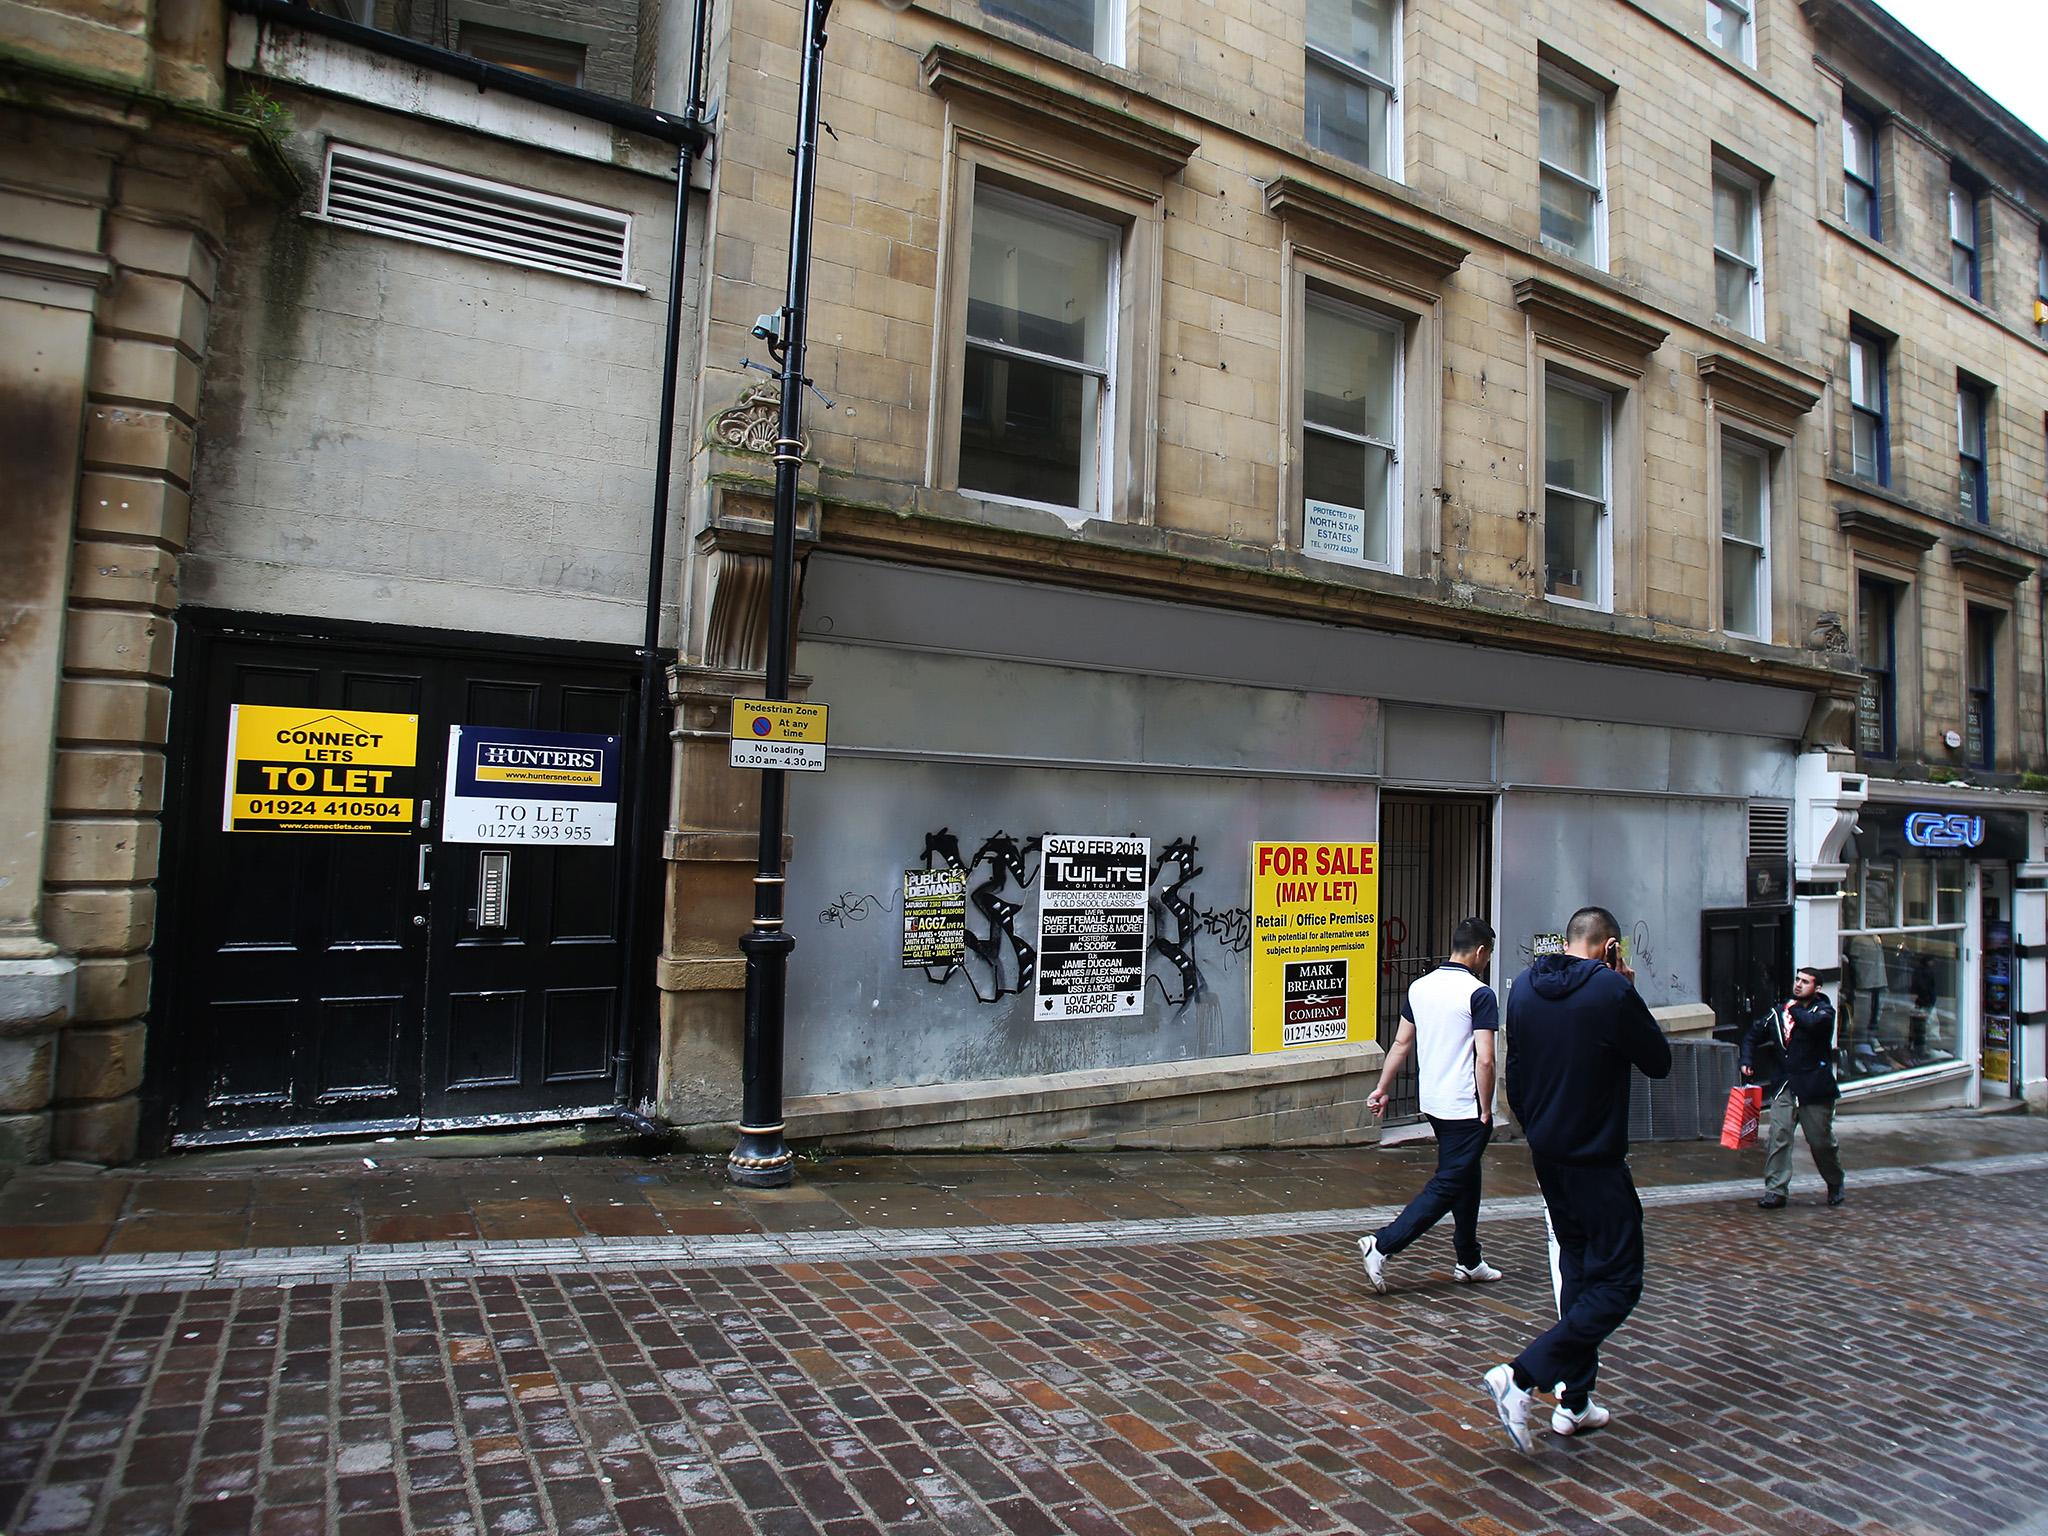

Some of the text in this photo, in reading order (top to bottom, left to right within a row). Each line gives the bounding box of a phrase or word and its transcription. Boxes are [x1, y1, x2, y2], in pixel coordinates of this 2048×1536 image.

[1313, 506, 1347, 518] PROTECTED
[1310, 516, 1359, 533] NORTH STAR
[1318, 529, 1352, 543] ESTATES
[744, 703, 818, 715] Pedestrian Zone
[276, 730, 383, 747] CONNECT
[784, 729, 803, 737] time
[305, 749, 353, 762] LETS
[771, 745, 804, 755] loading
[485, 747, 595, 768] HUNTERS
[735, 755, 761, 764] 10.30
[784, 758, 806, 766] 4.30
[262, 766, 392, 793] TO LET
[505, 772, 593, 782] www.huntersnet.co.uk
[250, 800, 401, 816] 01924 410504
[495, 805, 580, 822] TO LET
[477, 824, 592, 840] 01274 393 955
[1050, 840, 1144, 855] SAT 9 FEB 2013
[1260, 847, 1373, 876] FOR SALE
[909, 872, 949, 886] PUBLIC
[908, 882, 962, 897] DEMAND
[1276, 882, 1357, 907] (MAY LET)
[918, 917, 946, 930] AGGZ
[1043, 915, 1144, 924] SWEET FEMALE ATTITUDE
[1256, 915, 1287, 927] Retail
[1296, 913, 1326, 926] Office
[1330, 912, 1374, 925] Premises
[1069, 924, 1108, 933] FLOWERS
[1109, 924, 1115, 932] &
[1116, 923, 1141, 932] MORE!
[1261, 933, 1276, 942] with
[1278, 932, 1308, 943] potential
[1320, 930, 1354, 939] alternative
[1536, 936, 1557, 946] PUBLIC
[1070, 942, 1116, 951] MC SCORPZ
[1266, 945, 1291, 956] subject
[1301, 944, 1329, 957] planning
[1331, 942, 1364, 954] permission
[1062, 959, 1122, 969] JAMIE DUGGAN
[1300, 964, 1333, 977] MARK
[1041, 970, 1060, 978] RYAN
[1061, 969, 1085, 977] JAMES
[1091, 968, 1109, 976] ALEX
[1110, 967, 1141, 975] SIMMONS
[1052, 977, 1070, 986] MICK
[1072, 976, 1089, 984] TOLE
[1096, 976, 1116, 984] SEAN
[1288, 978, 1344, 992] BREARLEY
[1064, 994, 1117, 1005] LOVE APPLE
[1304, 994, 1329, 1004] &
[1066, 1004, 1115, 1014] BRADFORD
[1290, 1006, 1341, 1020] COMPANY
[1284, 1022, 1346, 1041] 01274 595999
